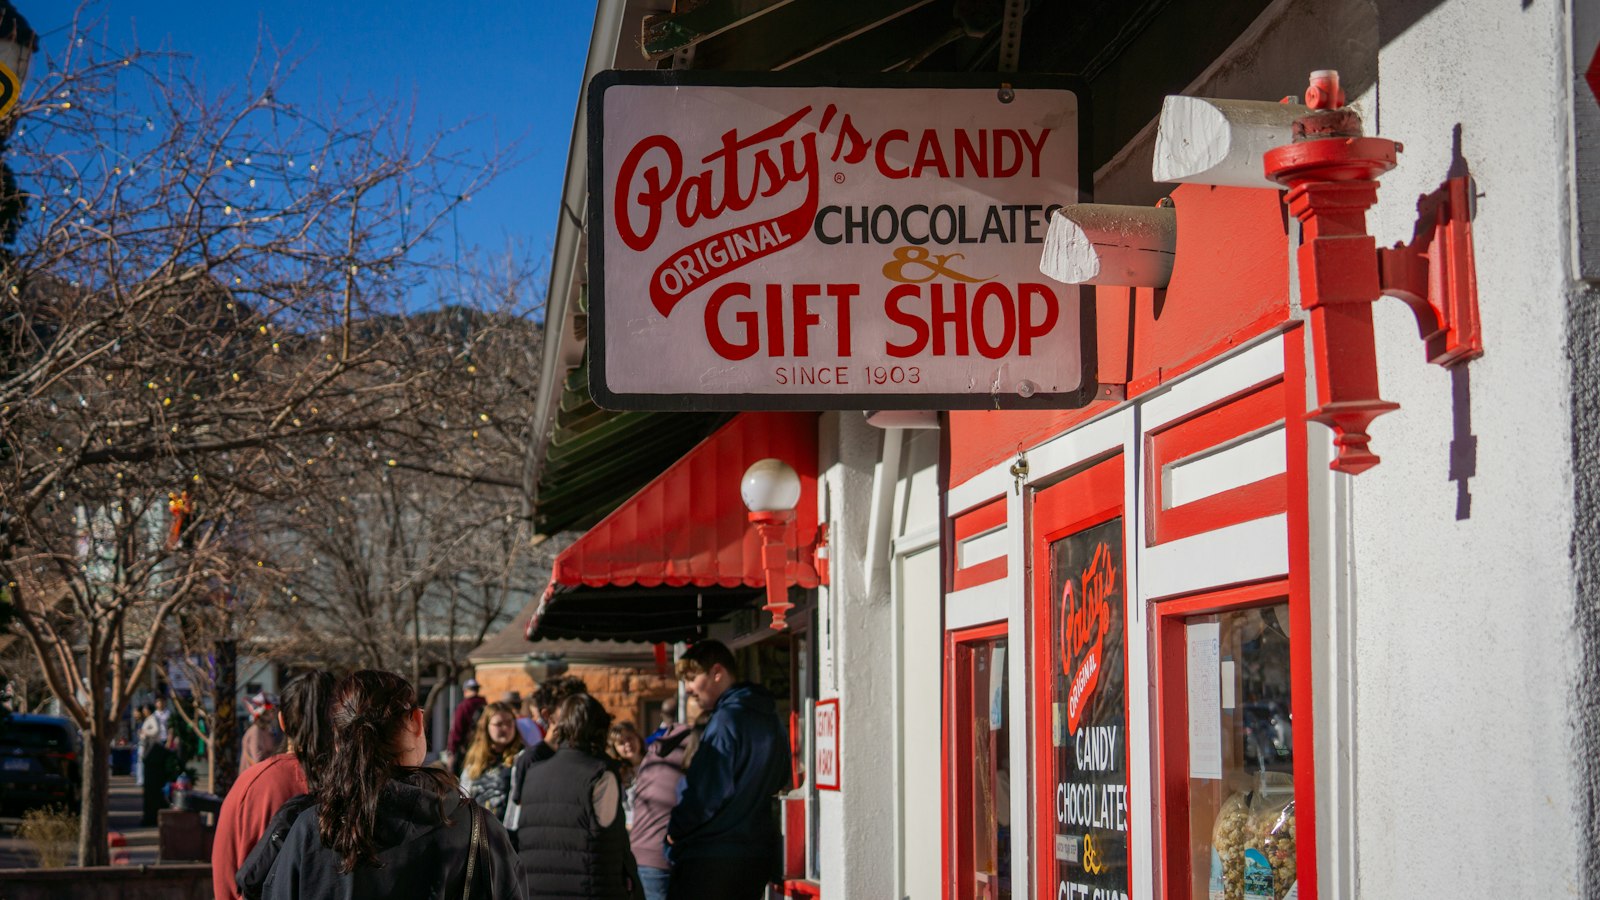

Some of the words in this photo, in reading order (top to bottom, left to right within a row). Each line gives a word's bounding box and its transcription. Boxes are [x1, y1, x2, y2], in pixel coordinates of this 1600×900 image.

[614, 104, 872, 251] Patsy's
[875, 128, 1050, 179] CANDY
[660, 221, 791, 295] ORIGINAL
[882, 246, 998, 284] &
[704, 282, 860, 361] GIFT
[884, 282, 1060, 360] SHOP
[776, 366, 849, 385] SINCE
[865, 366, 922, 385] 1903
[1061, 542, 1116, 675] Patsy's
[1069, 653, 1097, 719] ORIGINAL
[1076, 725, 1117, 771] CANDY
[1083, 833, 1101, 876] &
